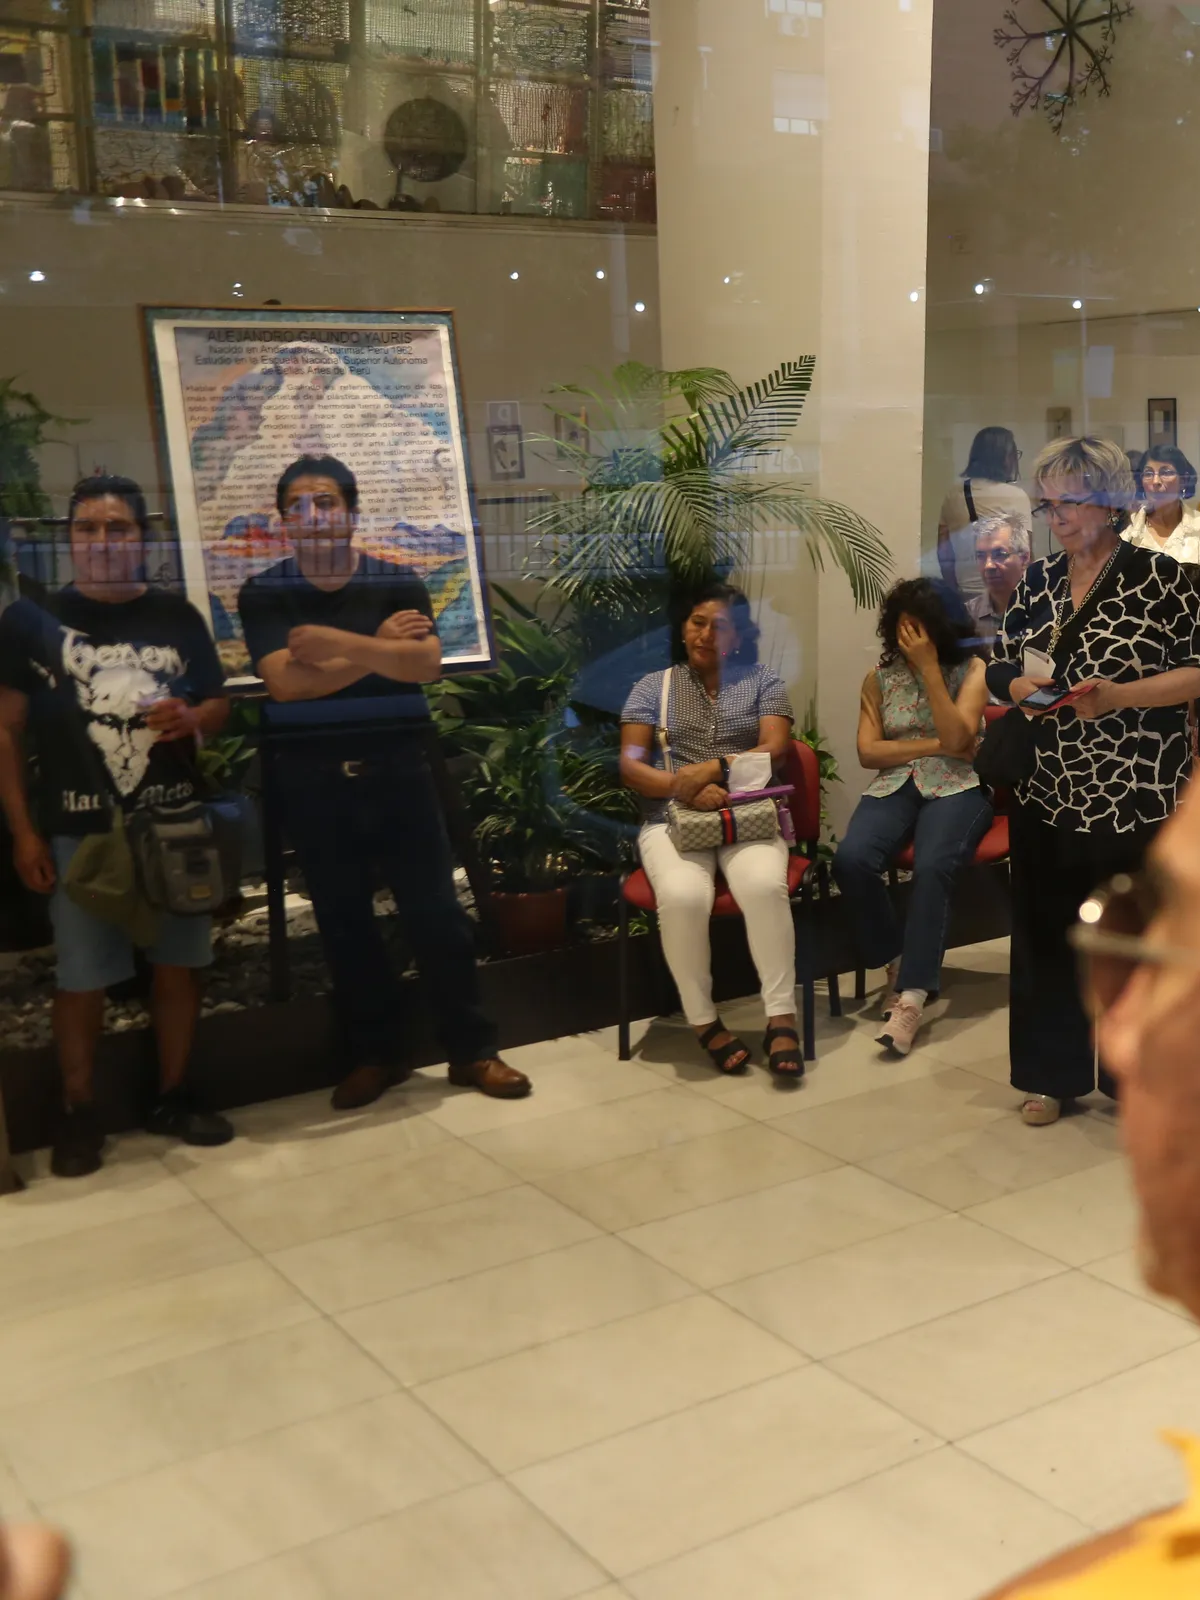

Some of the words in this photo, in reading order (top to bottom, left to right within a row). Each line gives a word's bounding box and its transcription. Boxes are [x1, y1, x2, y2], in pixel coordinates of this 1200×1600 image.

[208, 330, 294, 342] ALEJANDRO
[299, 330, 361, 343] GALINDO
[365, 331, 413, 343] YAURIS
[209, 344, 243, 354] Nacido
[246, 346, 258, 354] en
[392, 345, 413, 354] 1962
[234, 357, 247, 365] en
[249, 355, 258, 365] la
[261, 355, 298, 365] Escuela
[302, 355, 339, 365] Nacional
[344, 355, 380, 367] Superior
[261, 365, 273, 375] de
[275, 365, 304, 375] Bellas
[307, 365, 331, 375] Artes
[335, 365, 345, 375] del
[286, 383, 320, 391] Galindo
